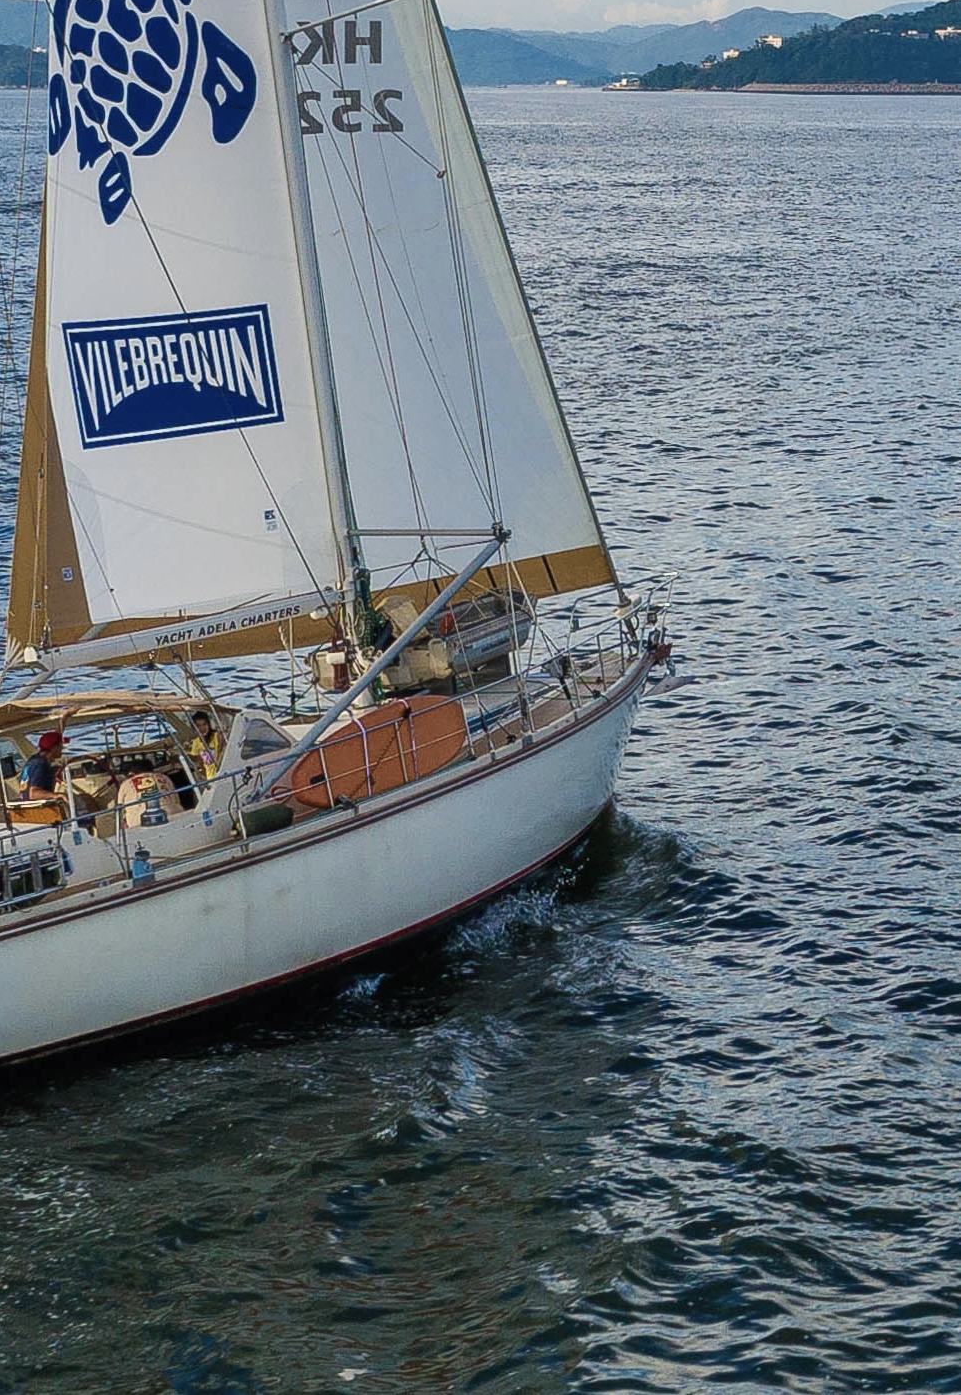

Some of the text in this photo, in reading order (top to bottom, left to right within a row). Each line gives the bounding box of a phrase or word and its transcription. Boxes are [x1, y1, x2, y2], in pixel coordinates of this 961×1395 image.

[75, 325, 267, 431] VILEBREQUIN
[155, 605, 301, 646] YACHT ADELA CHARTERS
